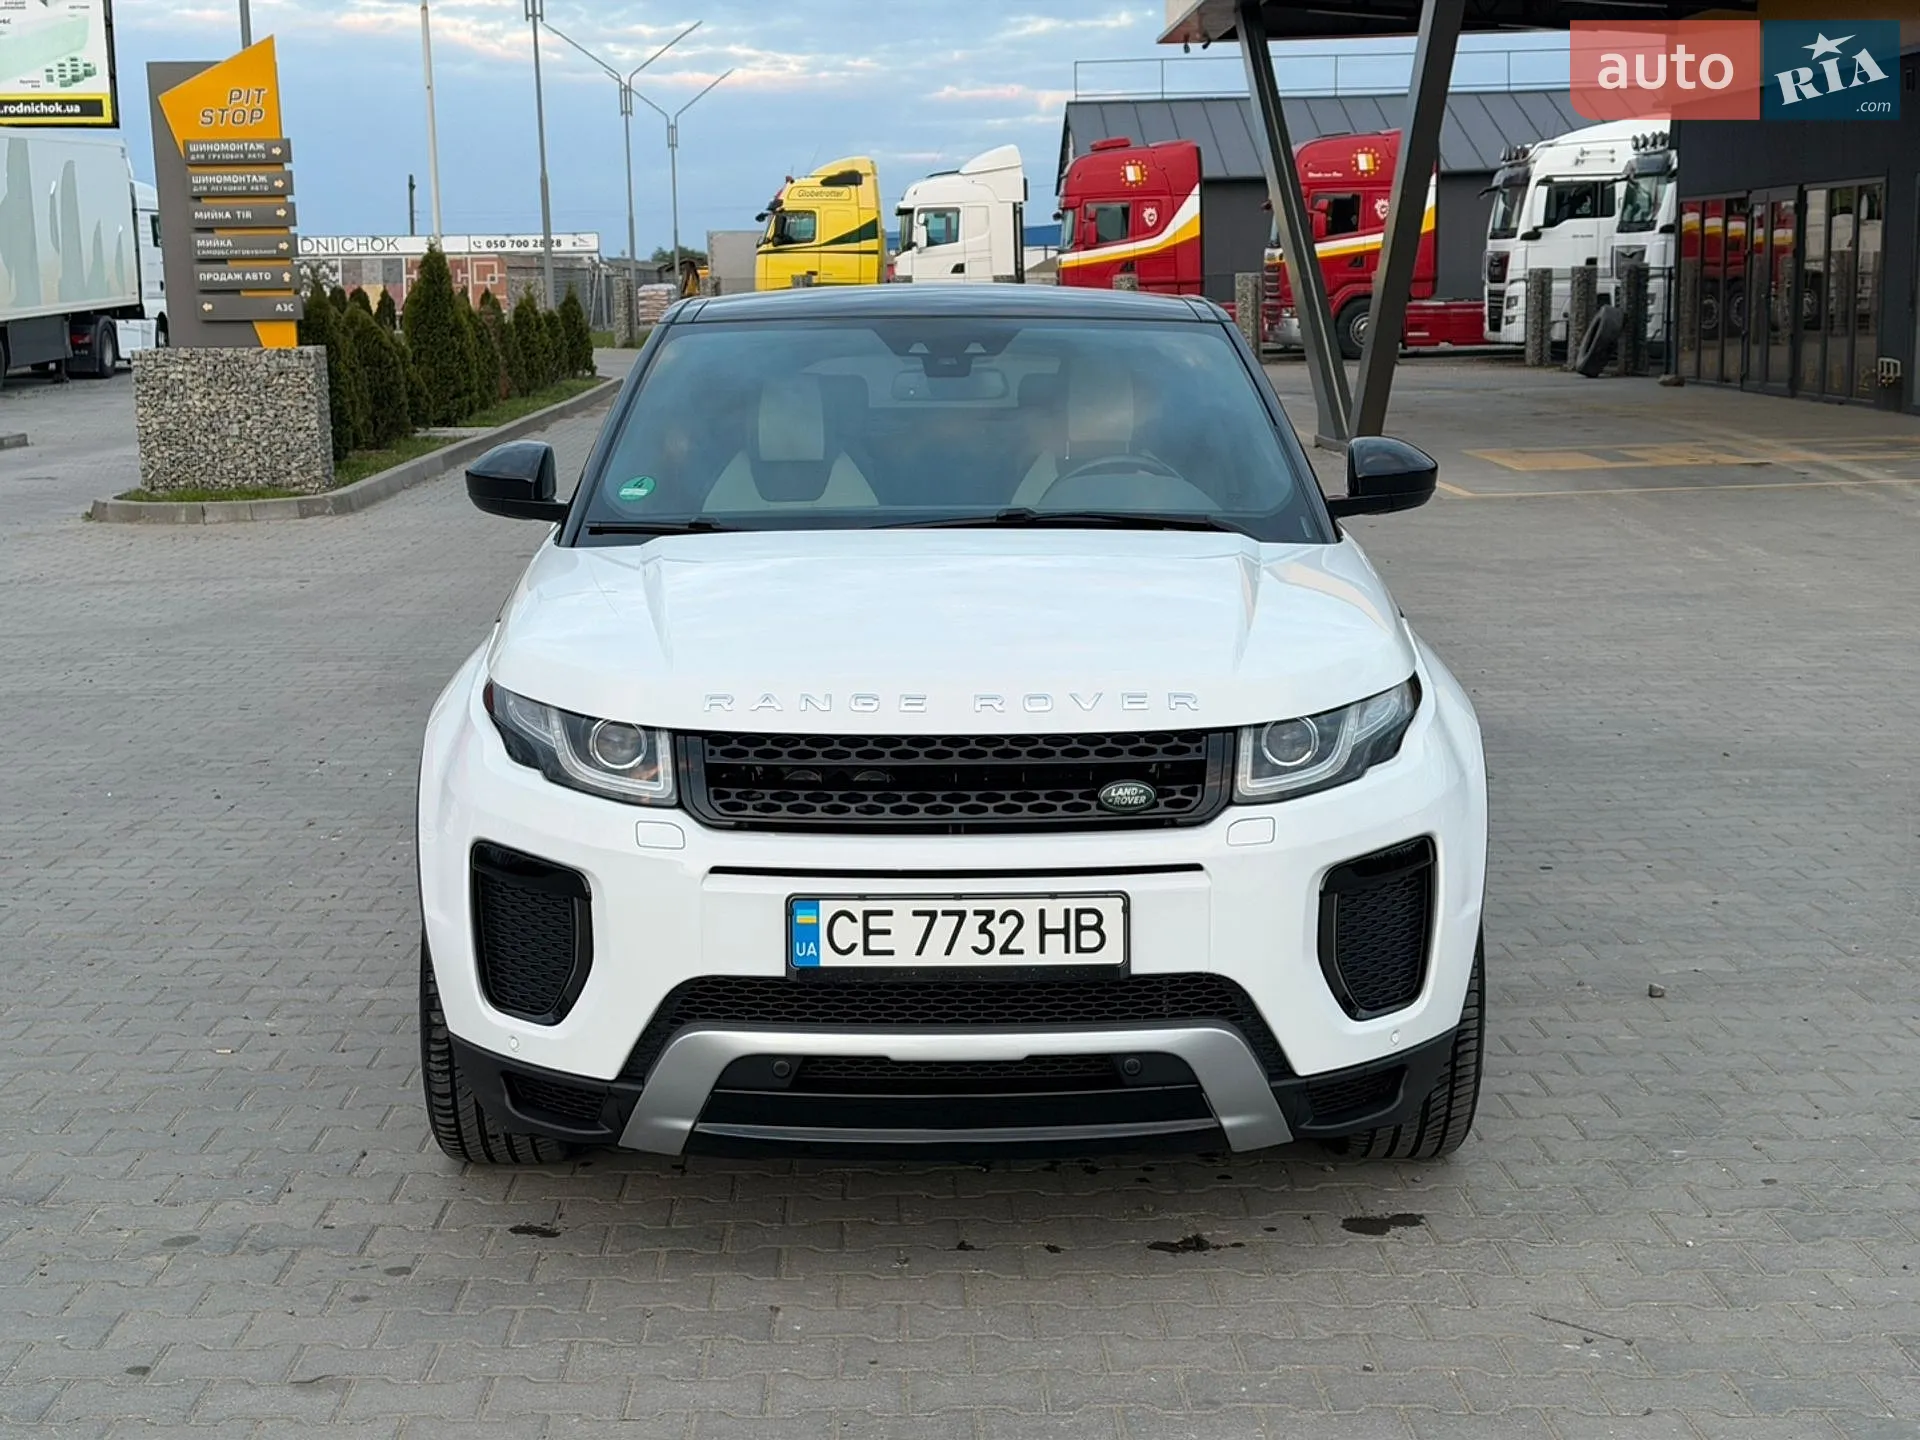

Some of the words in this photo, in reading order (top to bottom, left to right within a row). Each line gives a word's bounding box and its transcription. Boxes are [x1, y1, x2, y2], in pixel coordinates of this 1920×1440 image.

[228, 87, 267, 106] PIT
[199, 107, 265, 127] STOP
[189, 142, 265, 152] ШИНОМОНТАЖ
[192, 174, 267, 184] ШИНОМОНТАЖ
[194, 210, 231, 220] МИЙКА
[236, 210, 252, 220] TIR
[197, 238, 233, 248] МИЙКА
[486, 240, 506, 248] 050
[509, 239, 529, 248] 700
[199, 272, 242, 281] ПРОДАЖ
[245, 272, 271, 281] АВТО
[275, 303, 294, 312] АЗС
[703, 693, 928, 713] RANGE
[974, 692, 1200, 713] ROVER
[1111, 787, 1138, 796] LAND
[1113, 796, 1146, 805] ROVER
[826, 909, 895, 956] CE
[912, 908, 1025, 956] 7732
[1038, 907, 1107, 955] HB
[796, 942, 817, 957] UA
